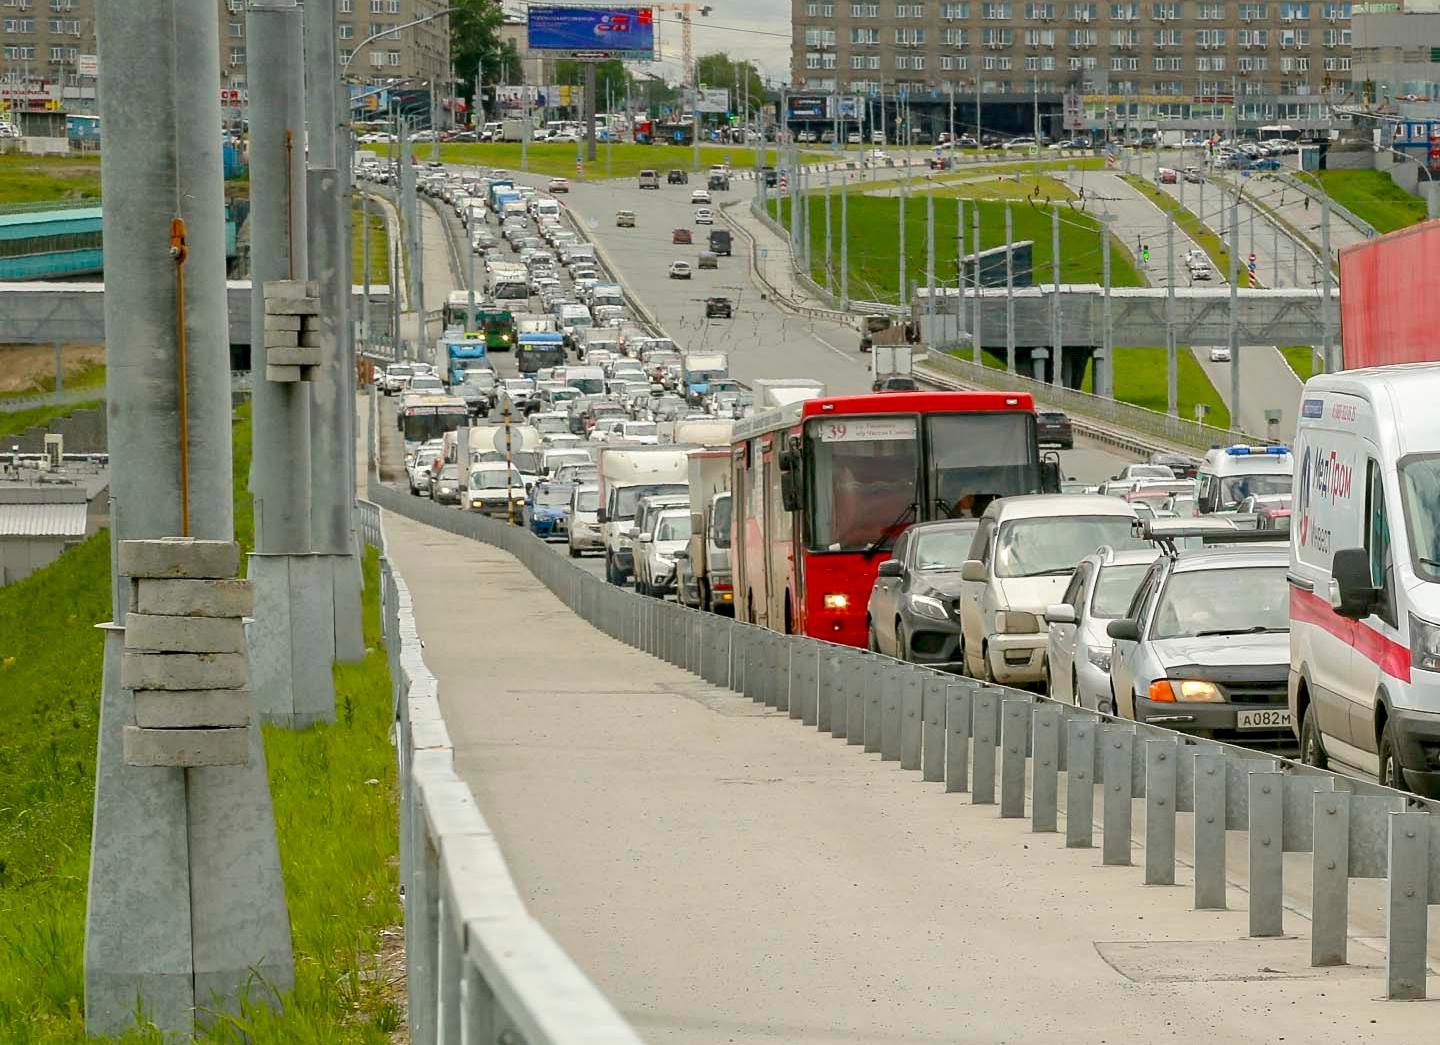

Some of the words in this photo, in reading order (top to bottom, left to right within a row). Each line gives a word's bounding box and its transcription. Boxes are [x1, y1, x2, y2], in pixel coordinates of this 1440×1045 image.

[828, 424, 847, 439] 39
[1312, 446, 1352, 506] МедПром
[1244, 711, 1291, 726] А082М
